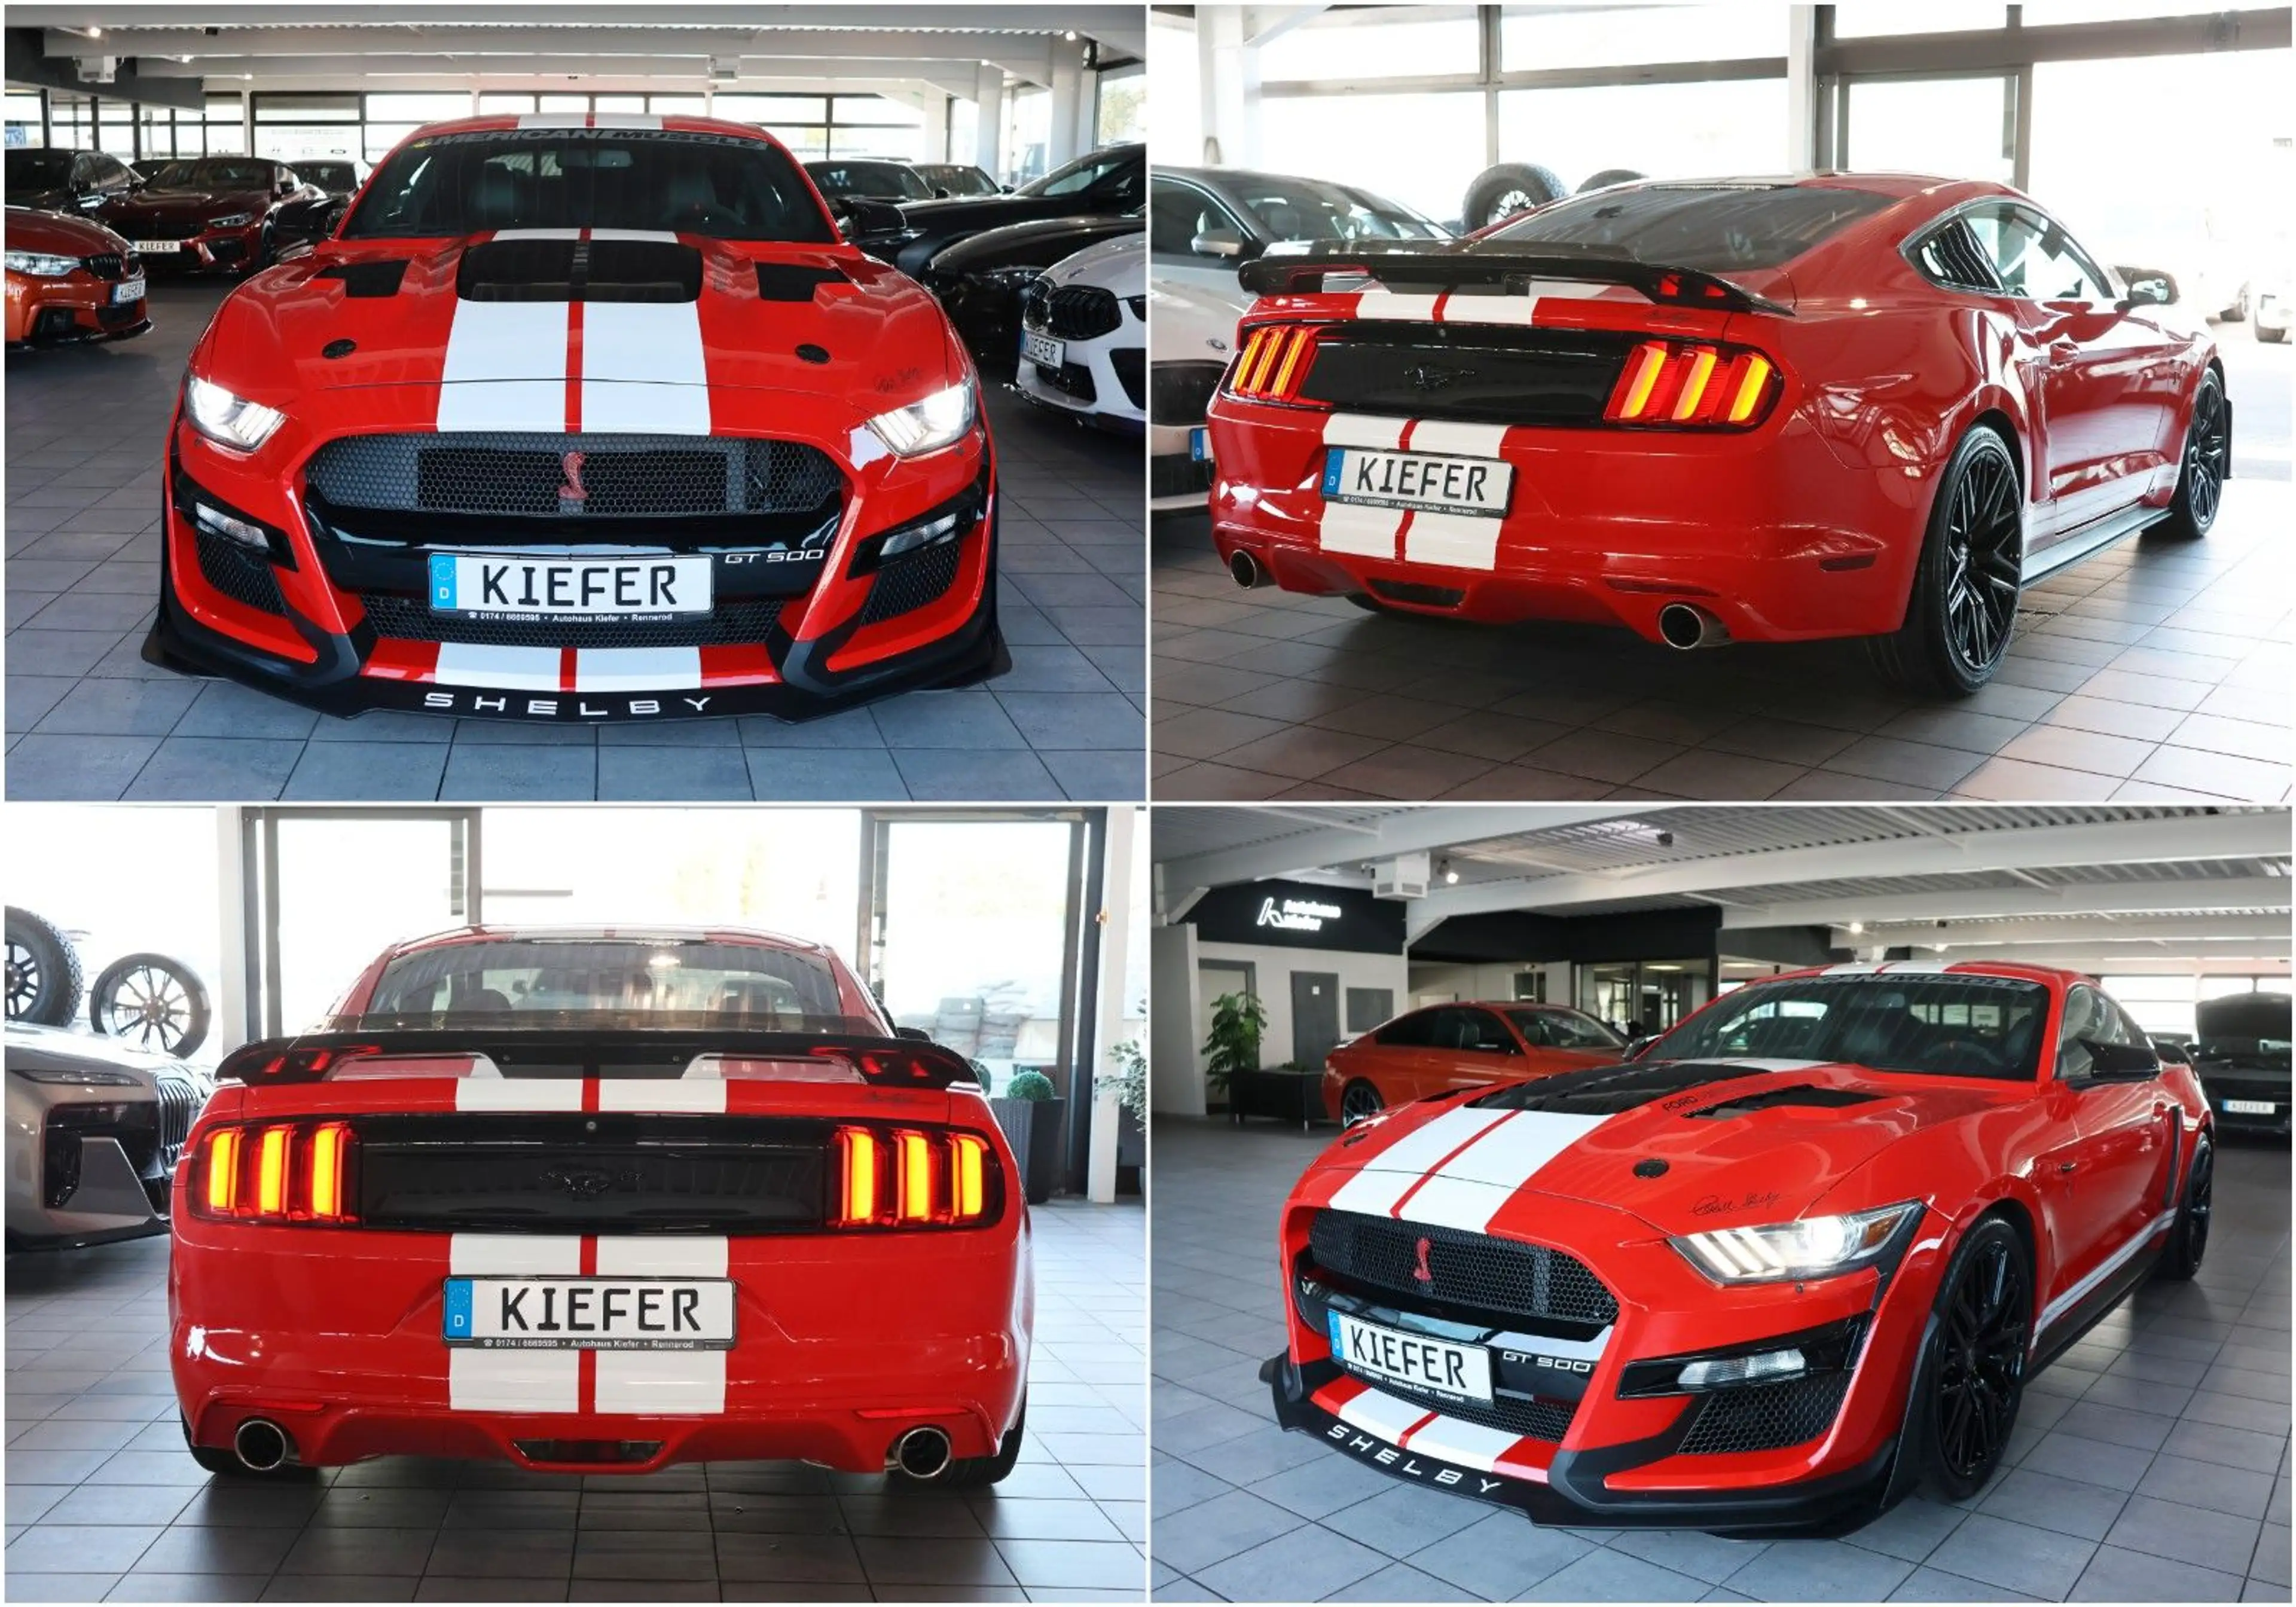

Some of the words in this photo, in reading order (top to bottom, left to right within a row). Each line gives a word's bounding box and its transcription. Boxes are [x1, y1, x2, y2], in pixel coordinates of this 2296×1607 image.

[1328, 475, 1336, 486] D
[1357, 456, 1487, 502] KIEFER
[725, 553, 761, 564] GT
[766, 549, 825, 563] 500
[439, 587, 449, 599] D
[482, 564, 677, 606] KIEFER
[552, 614, 592, 622] Autohaus
[595, 614, 619, 622] Kiefer
[631, 612, 673, 622] Rennerod
[424, 692, 711, 716] SHELBY
[501, 1287, 701, 1332] KIEFER
[454, 1315, 465, 1327] D
[570, 1339, 611, 1348] Autohaus
[1351, 1325, 1466, 1388] KIEFER
[1503, 1351, 1532, 1364] GT
[1537, 1357, 1591, 1373] 500
[1327, 1424, 1502, 1493] SHELBY
